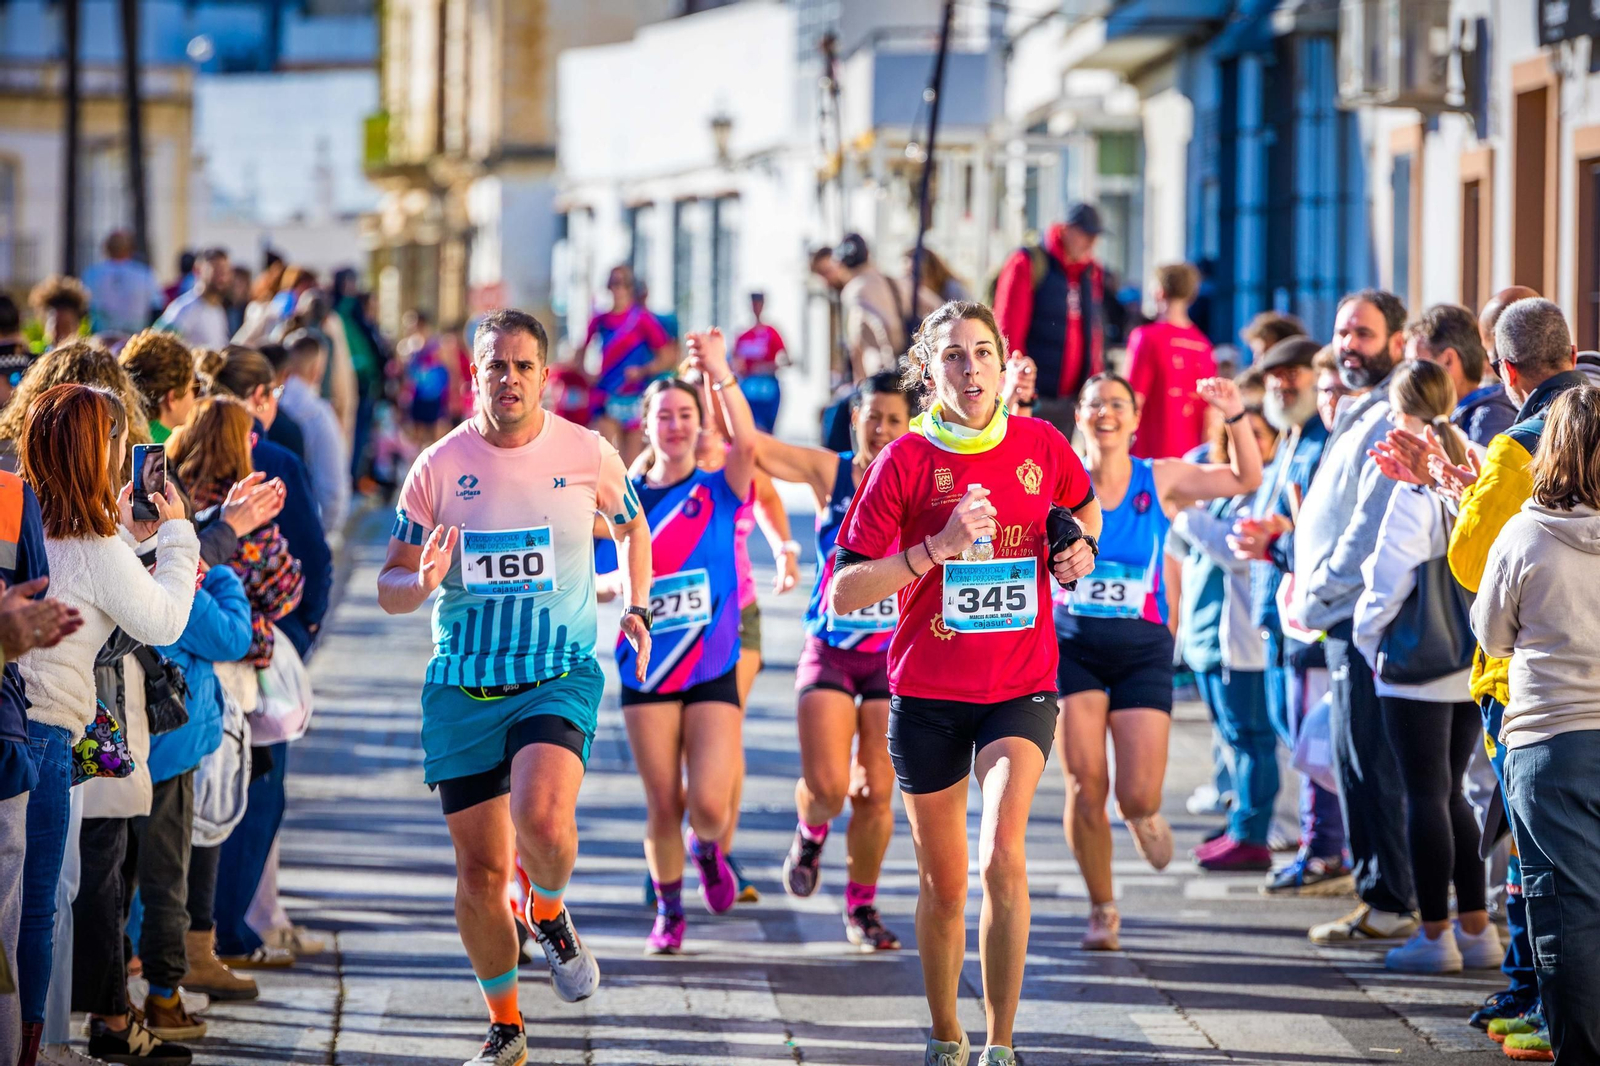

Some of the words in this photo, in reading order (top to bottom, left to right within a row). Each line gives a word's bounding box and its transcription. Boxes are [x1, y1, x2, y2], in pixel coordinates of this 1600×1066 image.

[1004, 525, 1023, 548] 10
[476, 552, 544, 579] 160
[492, 585, 522, 594] cajasur
[958, 584, 1026, 613] 345
[1091, 581, 1126, 602] 23
[651, 590, 701, 616] 275
[849, 598, 893, 617] 26
[973, 619, 1005, 629] cajasur
